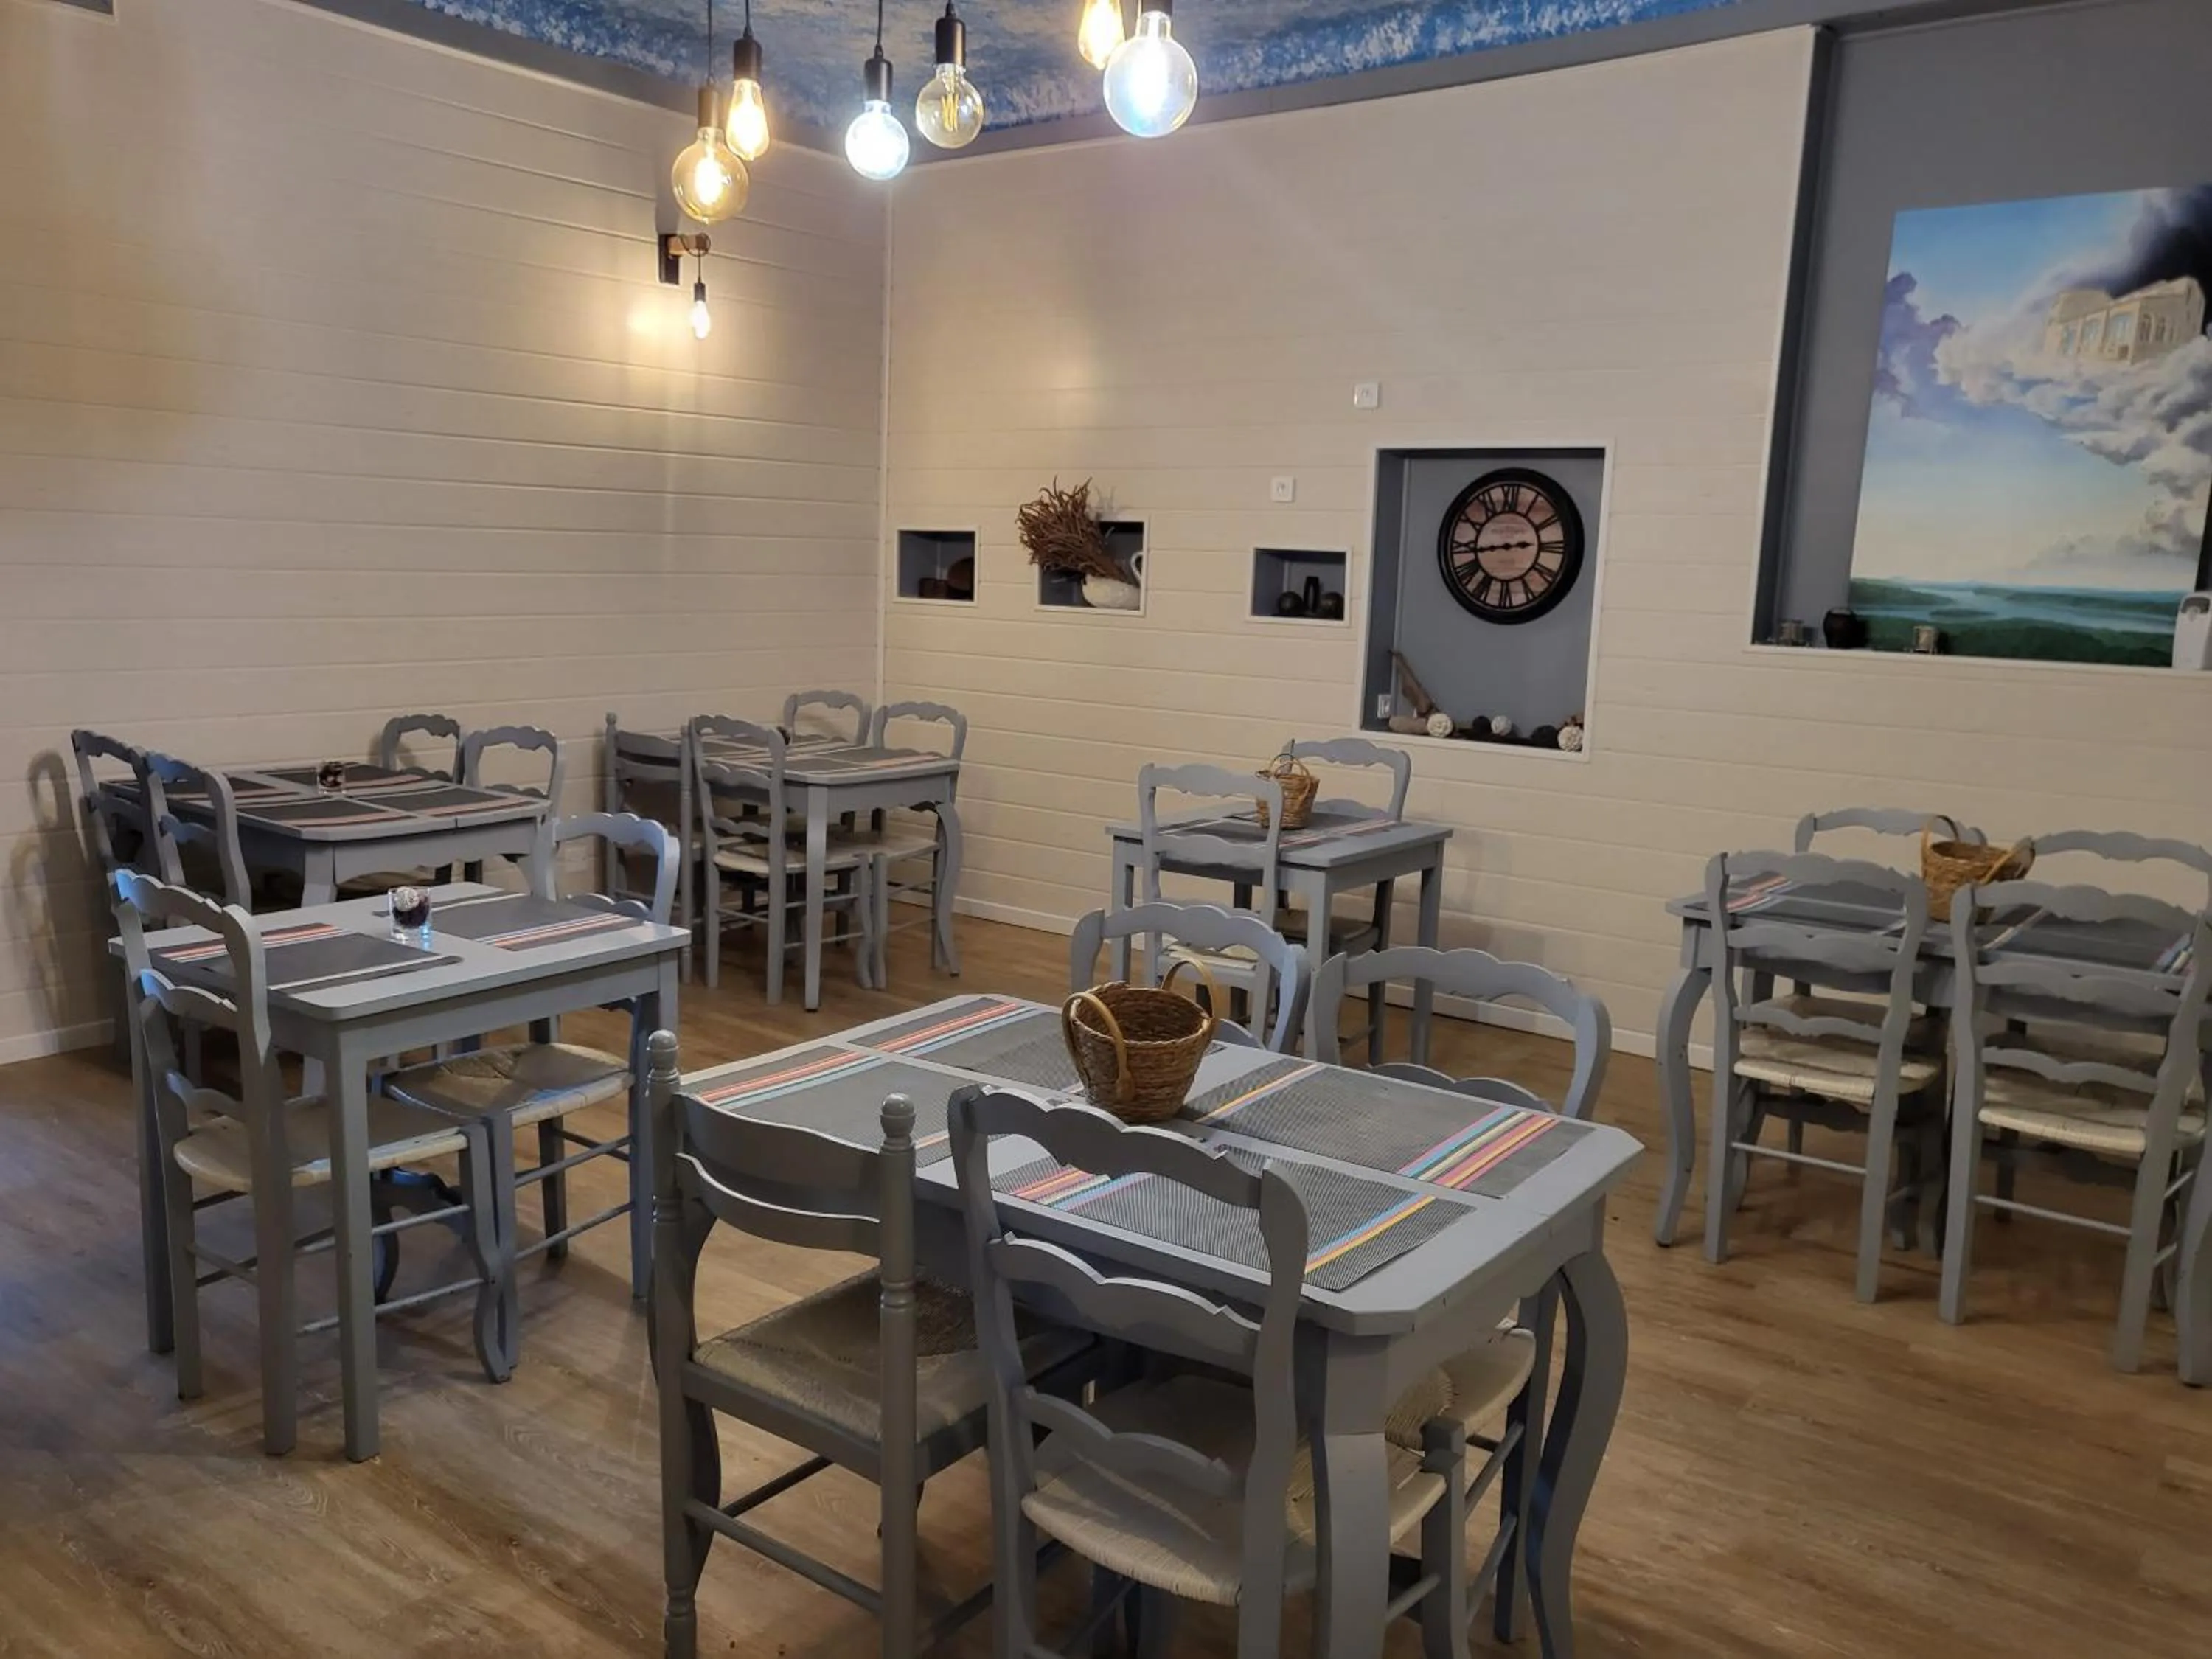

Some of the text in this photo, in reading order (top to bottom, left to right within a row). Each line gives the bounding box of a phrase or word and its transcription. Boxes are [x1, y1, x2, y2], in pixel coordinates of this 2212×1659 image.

[1477, 490, 1496, 518] XI
[1501, 484, 1520, 512] XII
[1458, 512, 1482, 532] X
[1537, 512, 1559, 530] II
[1452, 540, 1476, 554] IX
[1540, 540, 1565, 554] III
[1498, 581, 1513, 608] VI
[1521, 577, 1537, 602] V
